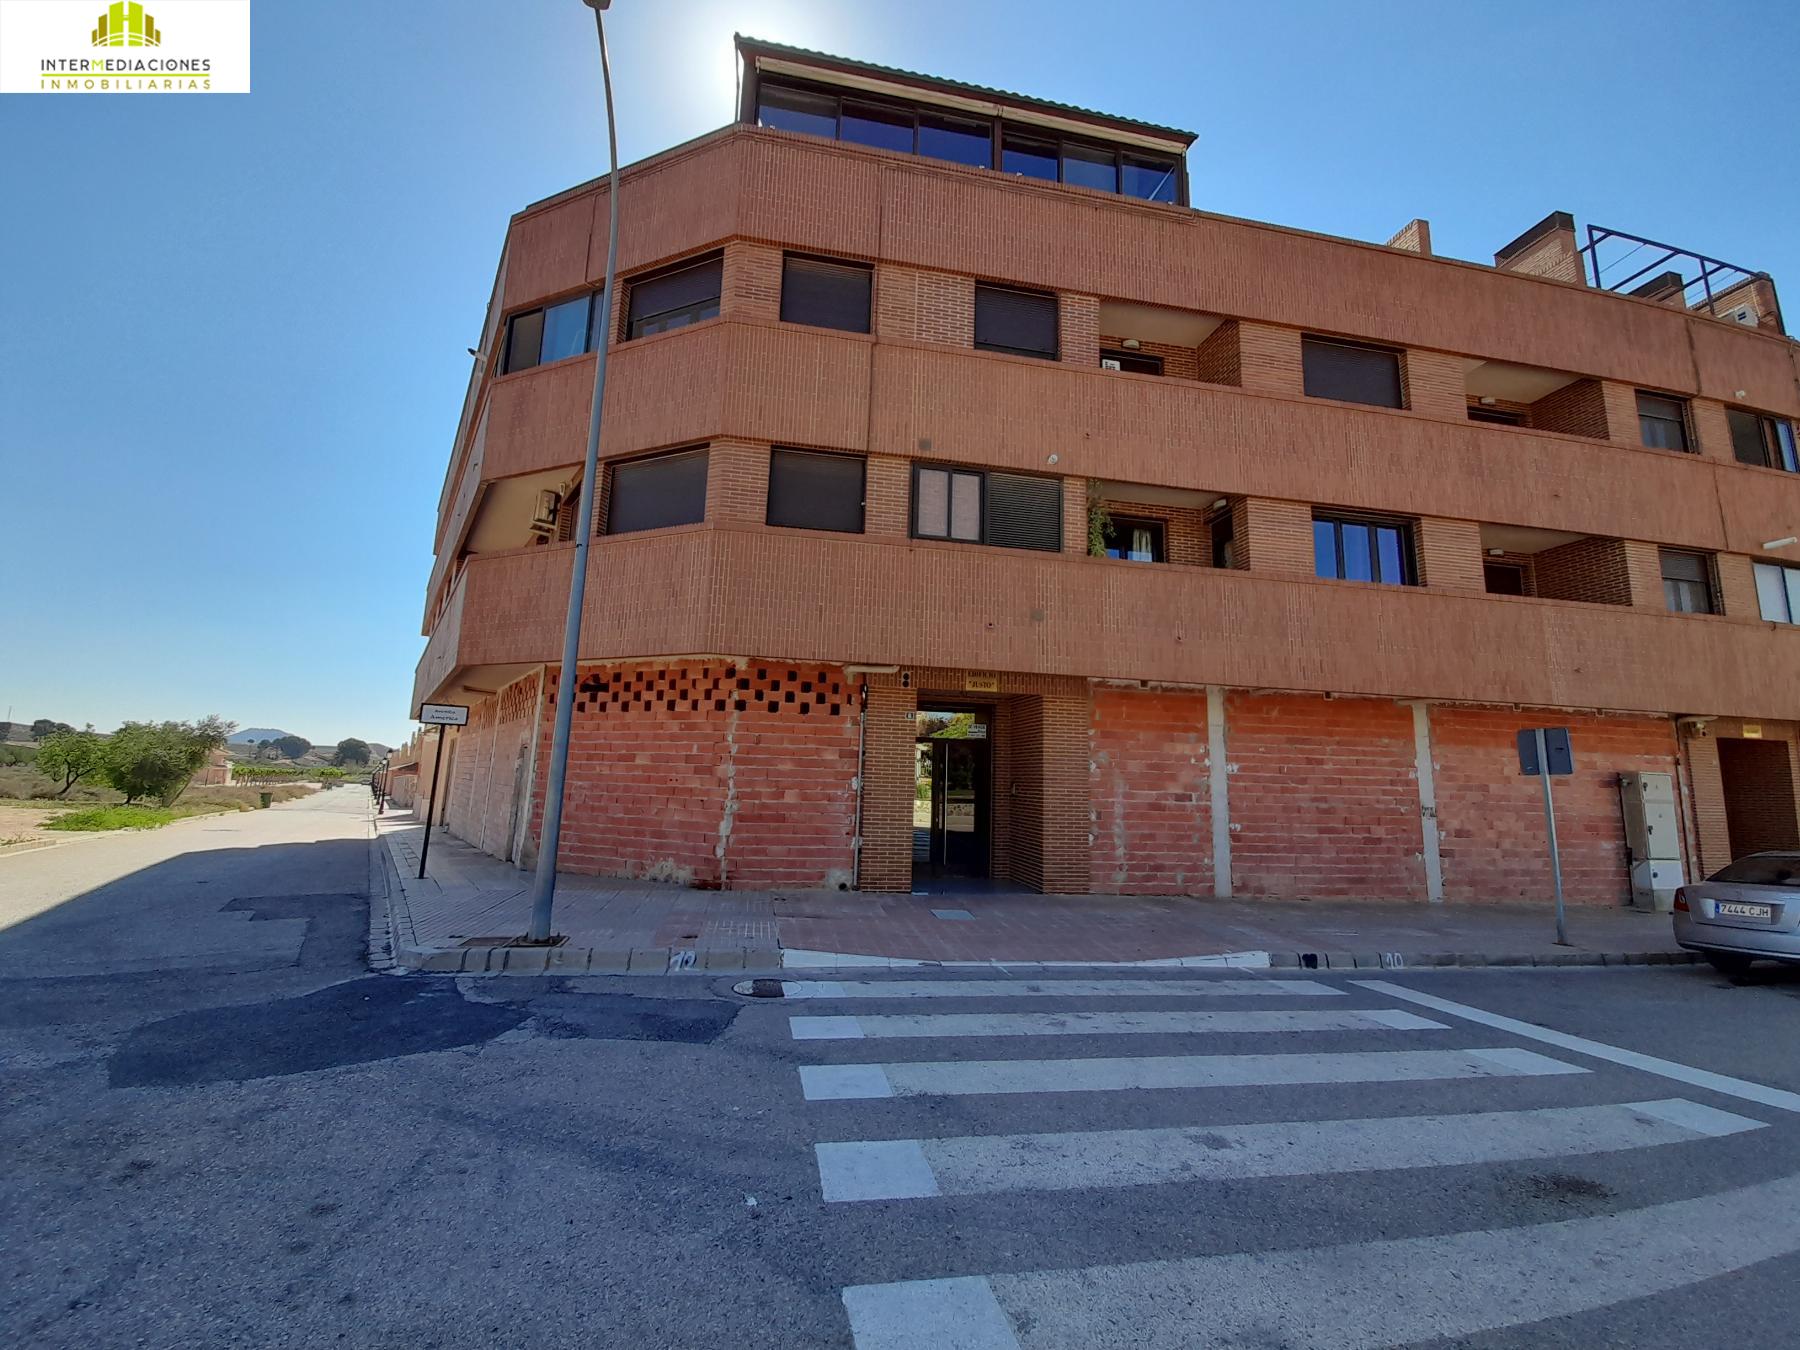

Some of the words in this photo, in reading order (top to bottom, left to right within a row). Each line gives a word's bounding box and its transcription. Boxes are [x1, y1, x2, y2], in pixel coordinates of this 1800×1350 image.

[1720, 904, 1746, 914] 7444
[1748, 907, 1769, 917] CJH
[1386, 952, 1404, 970] 10
